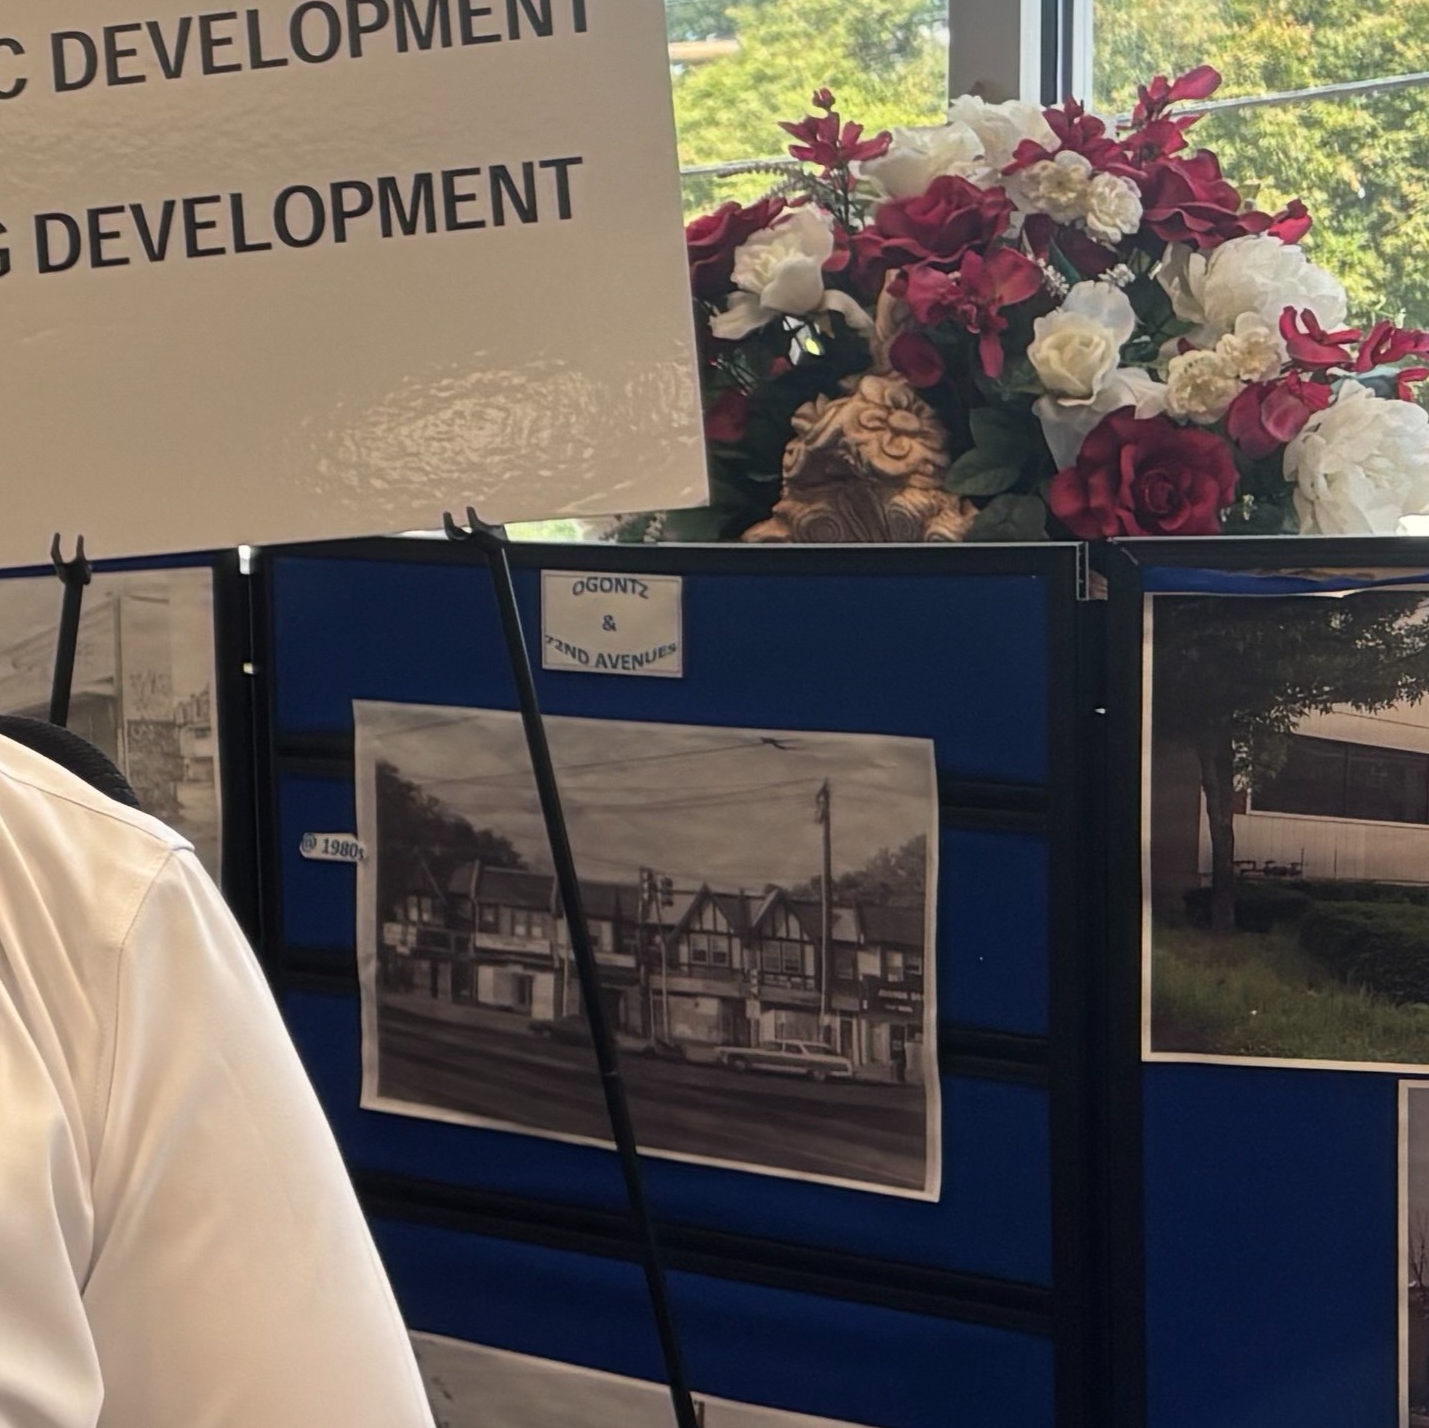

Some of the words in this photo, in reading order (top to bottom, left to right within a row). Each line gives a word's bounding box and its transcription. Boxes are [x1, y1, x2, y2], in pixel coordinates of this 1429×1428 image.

[35, 157, 583, 275] DEVELOPMENT
[572, 577, 649, 599] OGONTZ
[602, 615, 617, 631] &
[595, 643, 677, 670] AVENUES
